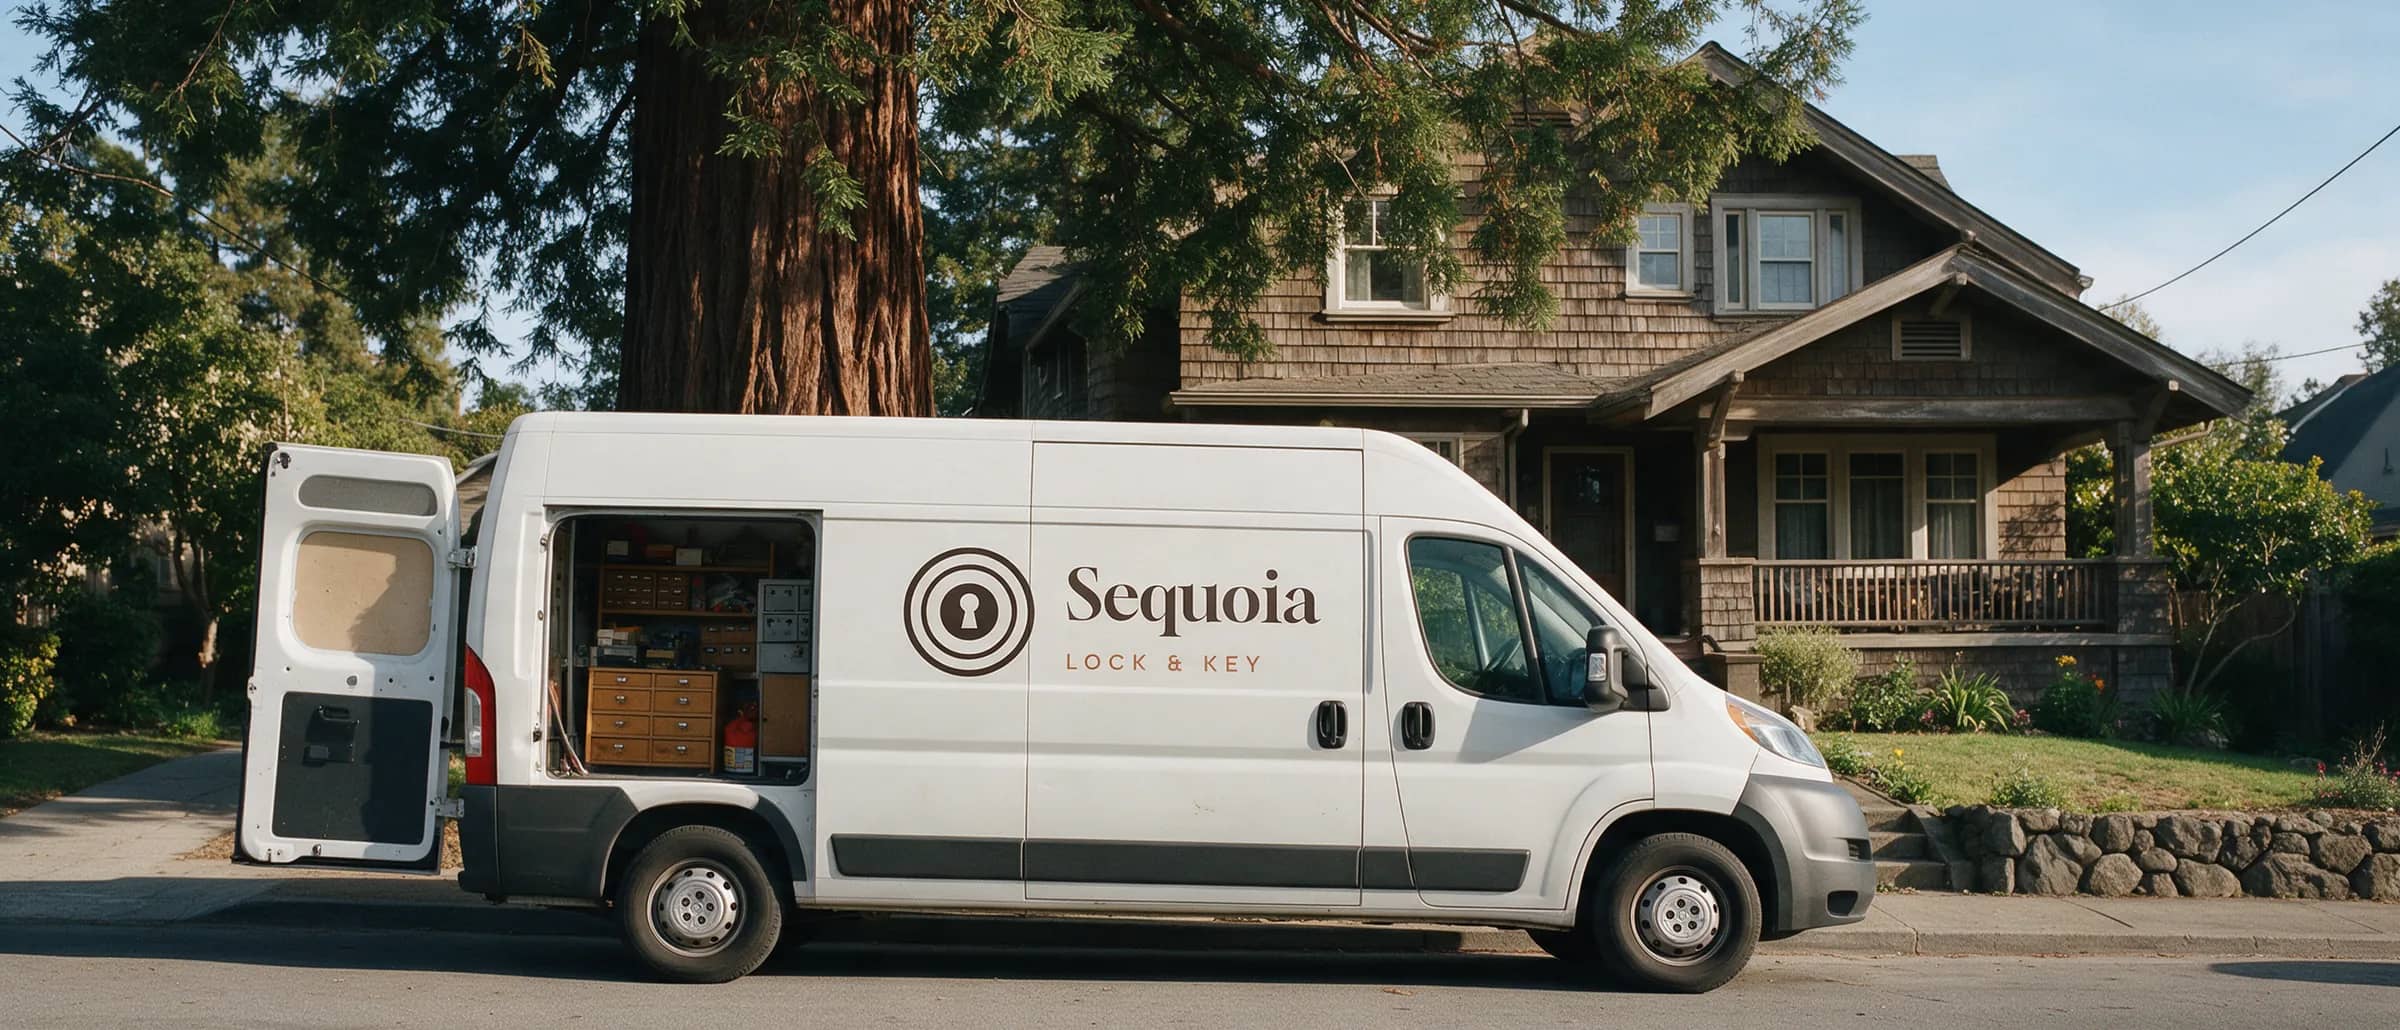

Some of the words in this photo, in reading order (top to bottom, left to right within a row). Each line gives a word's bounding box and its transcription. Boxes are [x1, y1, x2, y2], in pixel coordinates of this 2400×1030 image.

[1066, 566, 1321, 638] Sequoia
[1066, 653, 1147, 672] LOCK
[1167, 655, 1183, 672] &
[1204, 656, 1261, 673] KEY
